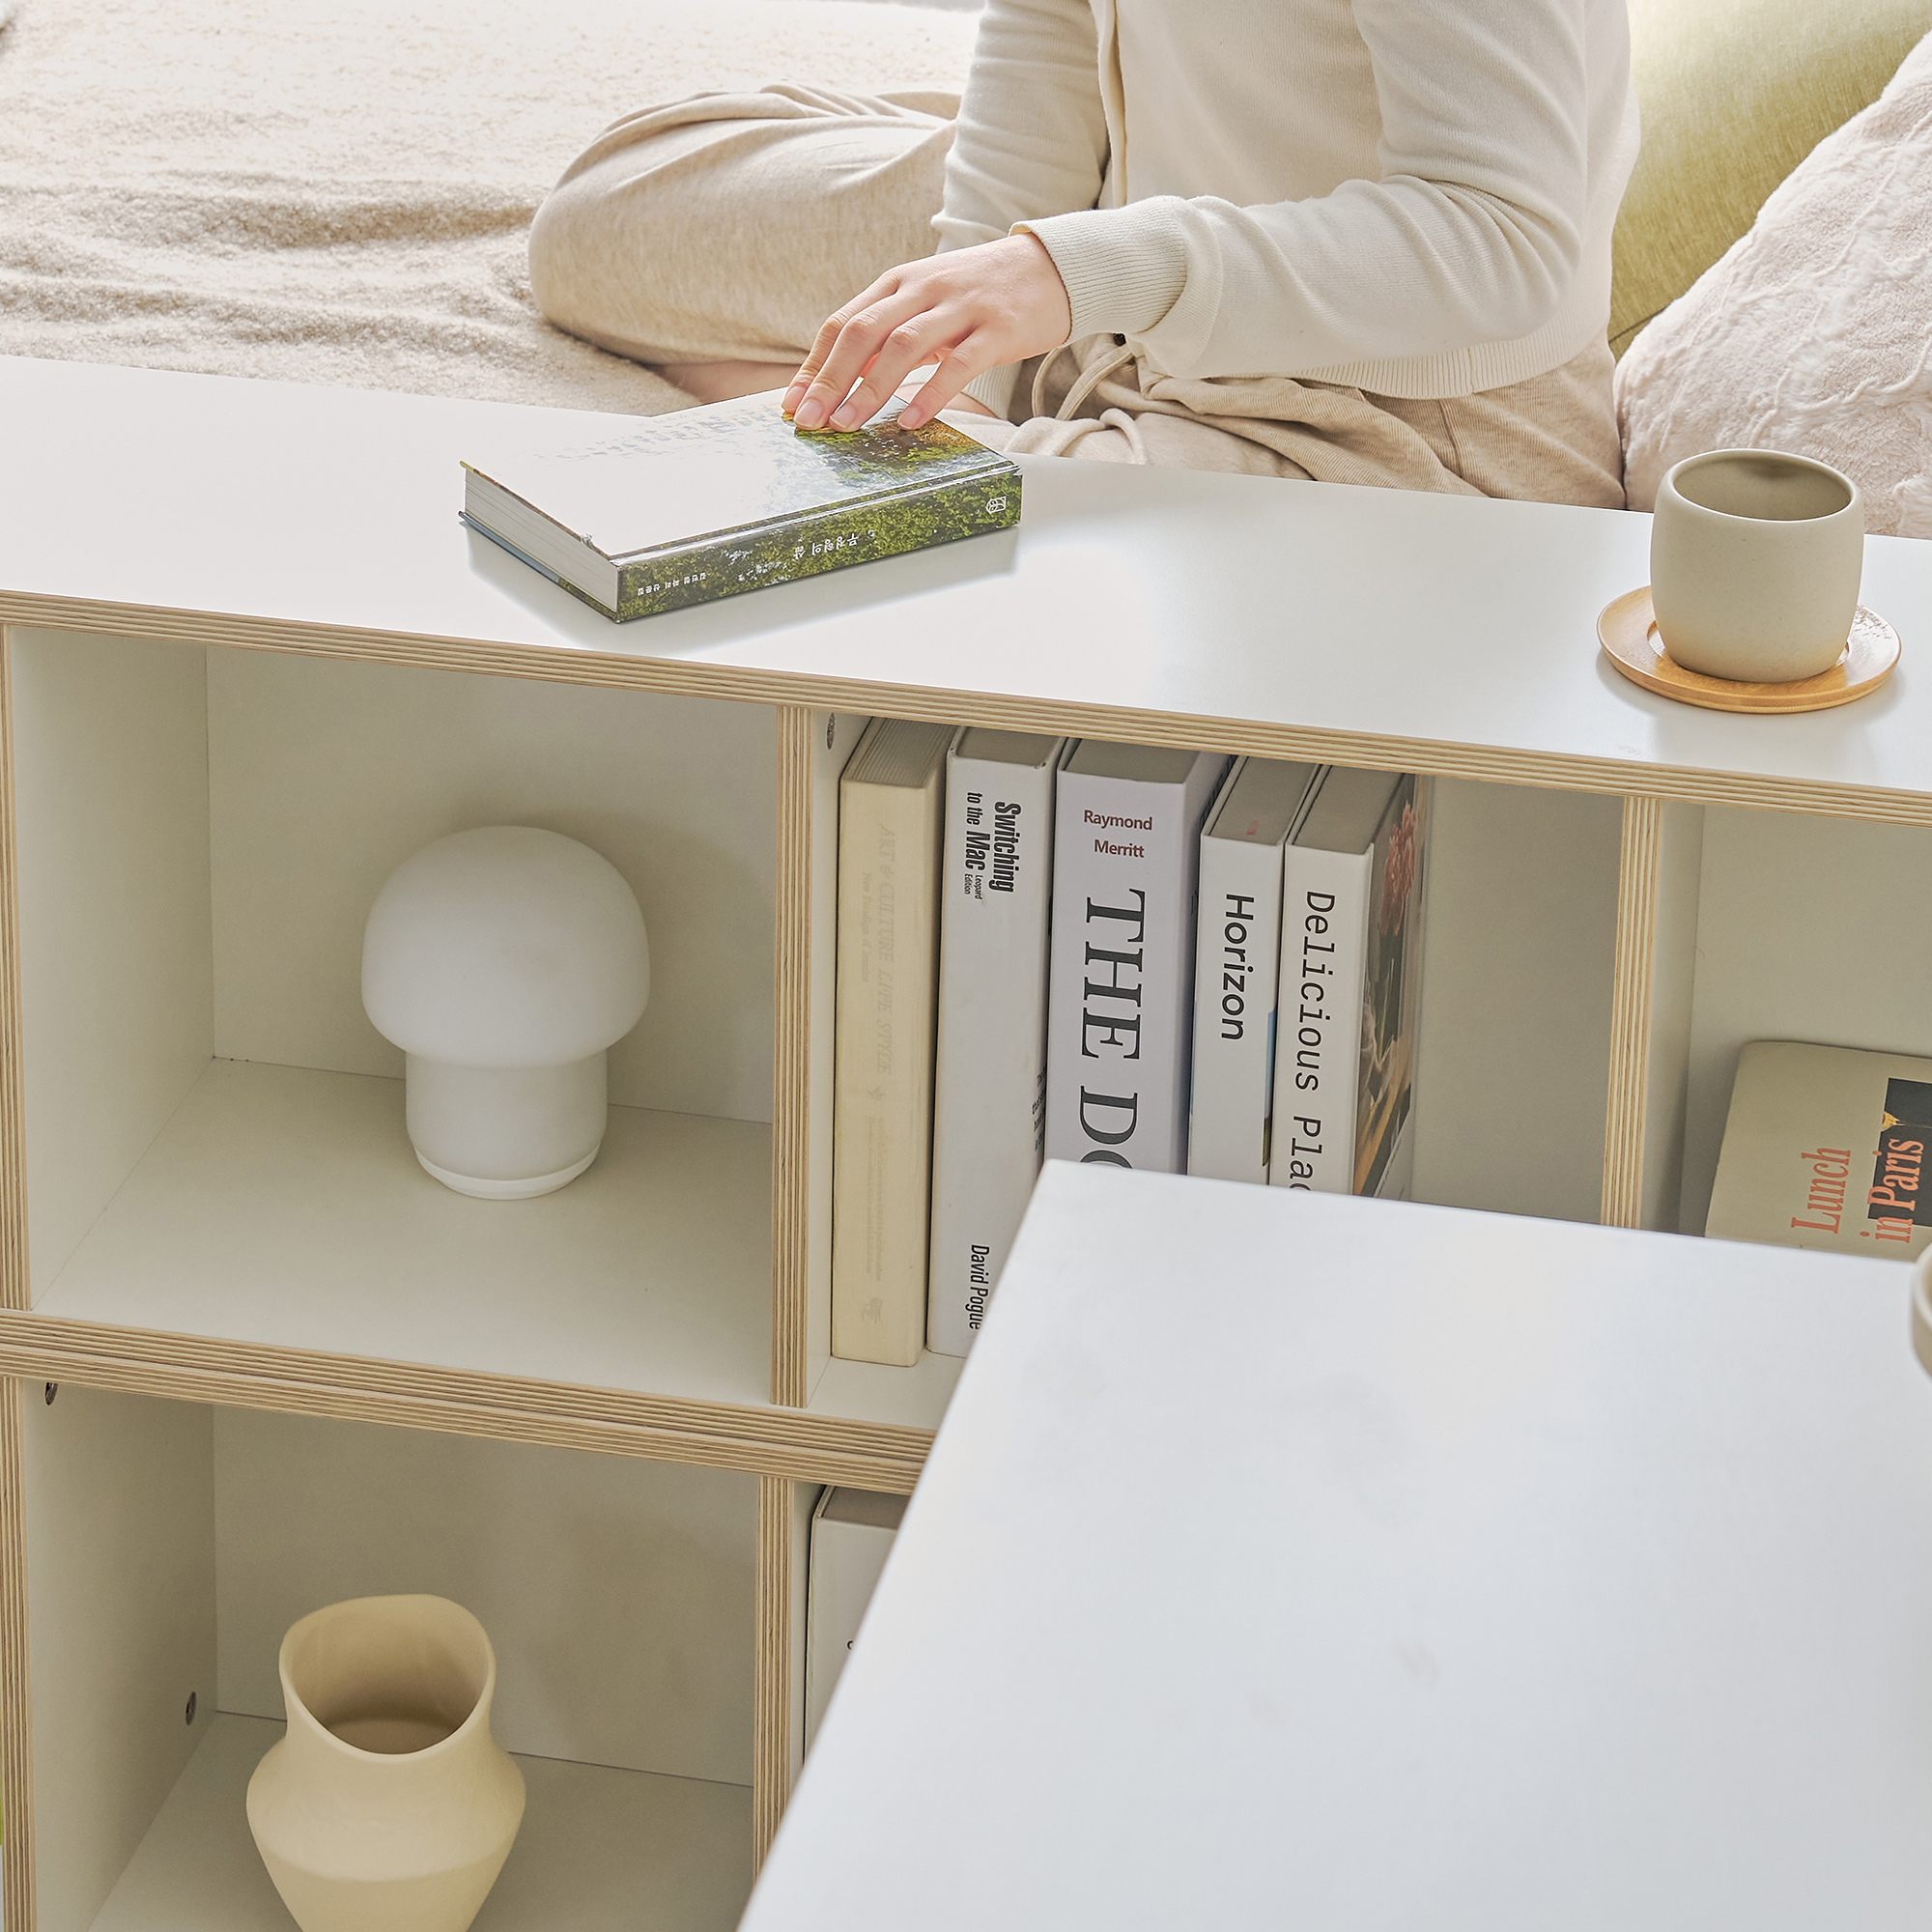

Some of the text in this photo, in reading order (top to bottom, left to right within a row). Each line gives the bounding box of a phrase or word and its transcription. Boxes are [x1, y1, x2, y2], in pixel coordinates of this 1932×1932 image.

[792, 532, 860, 561] 무정형의 삶
[878, 823, 895, 861] ART
[965, 792, 990, 870] to the Mac
[989, 802, 1021, 893] Switching
[1083, 809, 1153, 830] Raymond
[1094, 838, 1145, 858] Merritt
[877, 883, 895, 962] CULTURE
[964, 873, 973, 895] Edition
[975, 874, 983, 900] Leopard
[877, 969, 893, 1014] LIFE
[1081, 888, 1147, 1060] THE
[1222, 894, 1254, 1040] Horizon
[1295, 892, 1336, 1092] Delicious
[876, 1020, 893, 1075] STYLE
[1790, 1147, 1851, 1235] Lunch
[1860, 1138, 1924, 1243] in Paris
[964, 1244, 990, 1330] David Pogue
